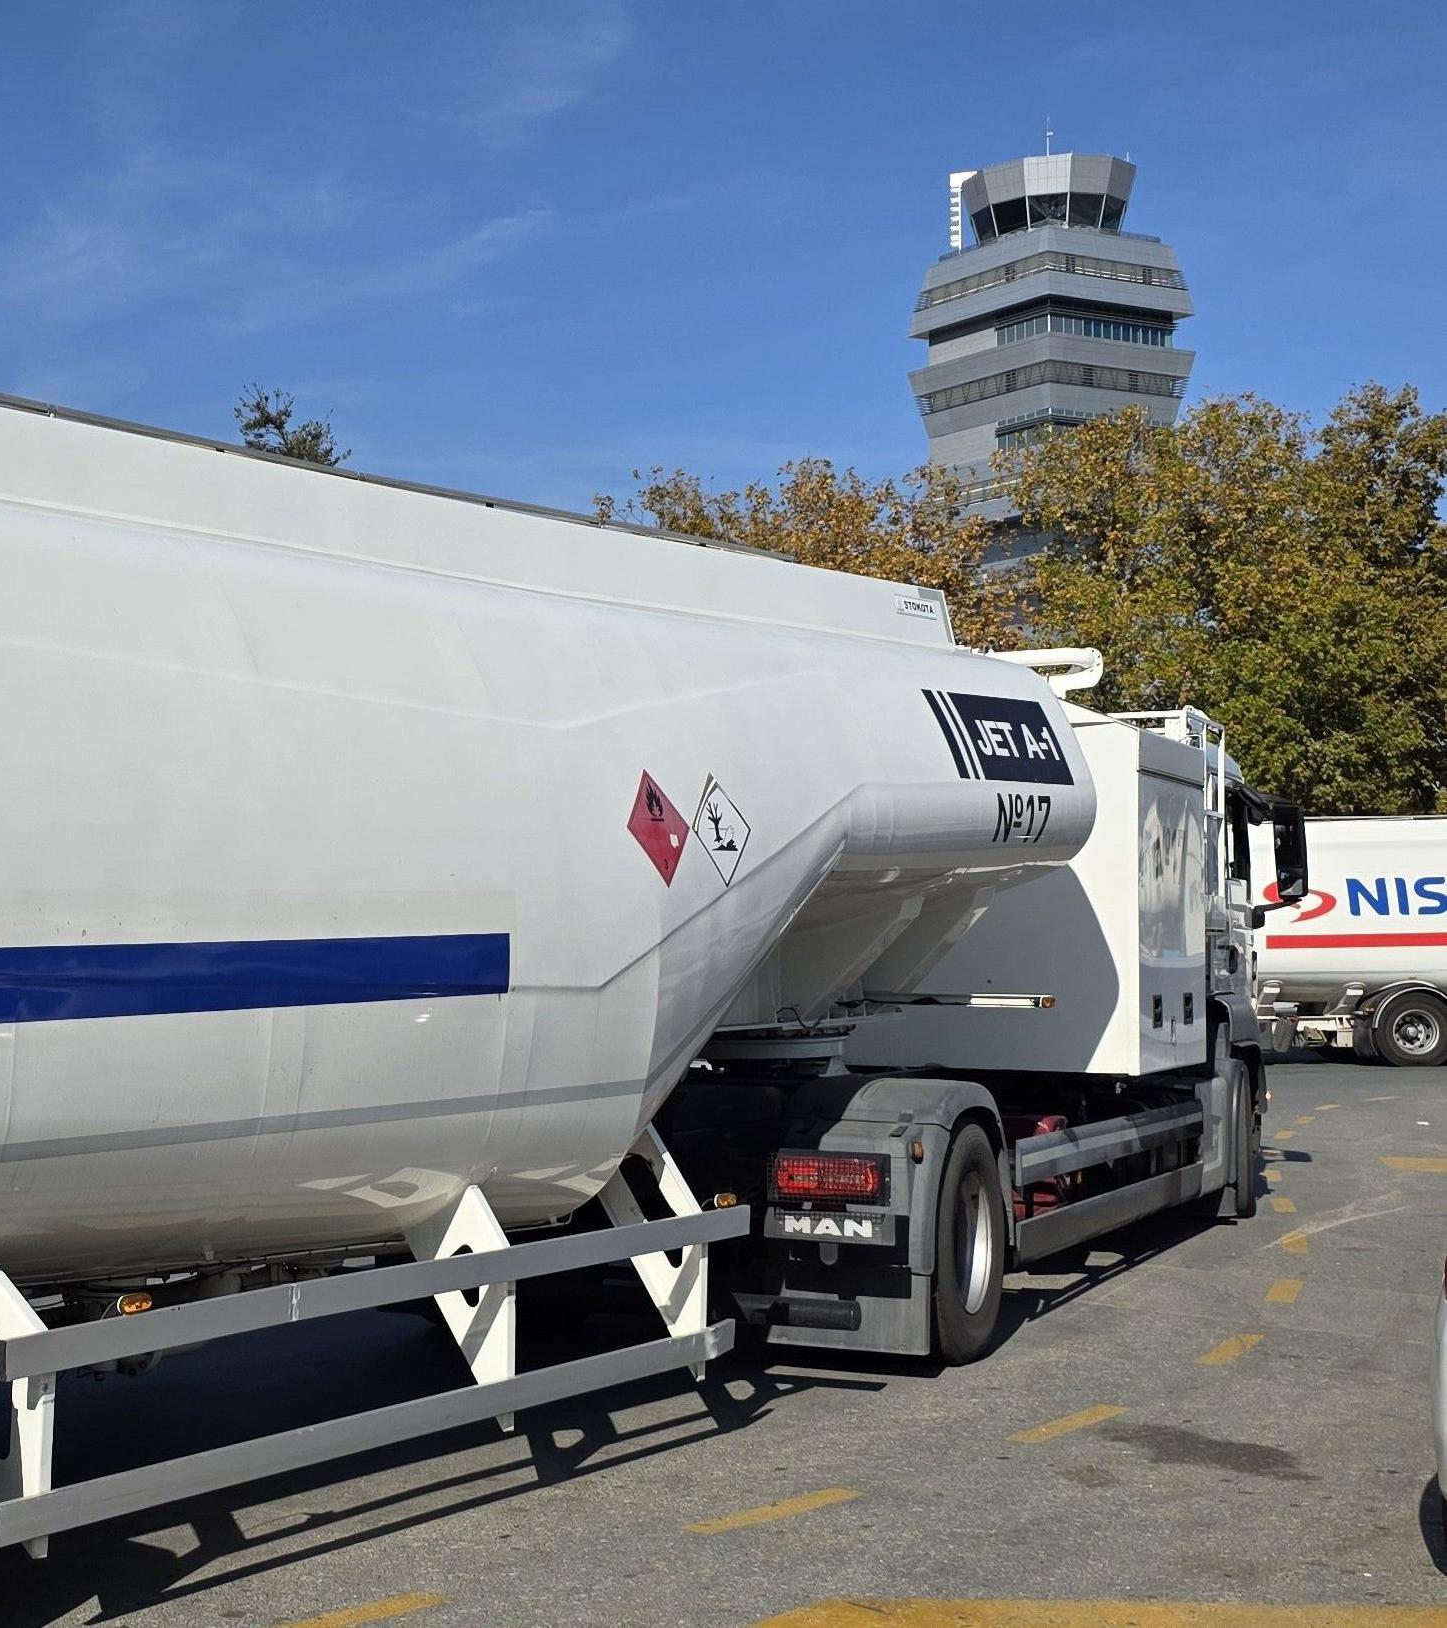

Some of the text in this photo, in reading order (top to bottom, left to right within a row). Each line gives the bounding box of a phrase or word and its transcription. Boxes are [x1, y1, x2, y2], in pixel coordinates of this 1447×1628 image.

[974, 719, 1060, 761] JET A-1
[1345, 876, 1447, 917] NIS
[784, 1215, 873, 1238] MAN
